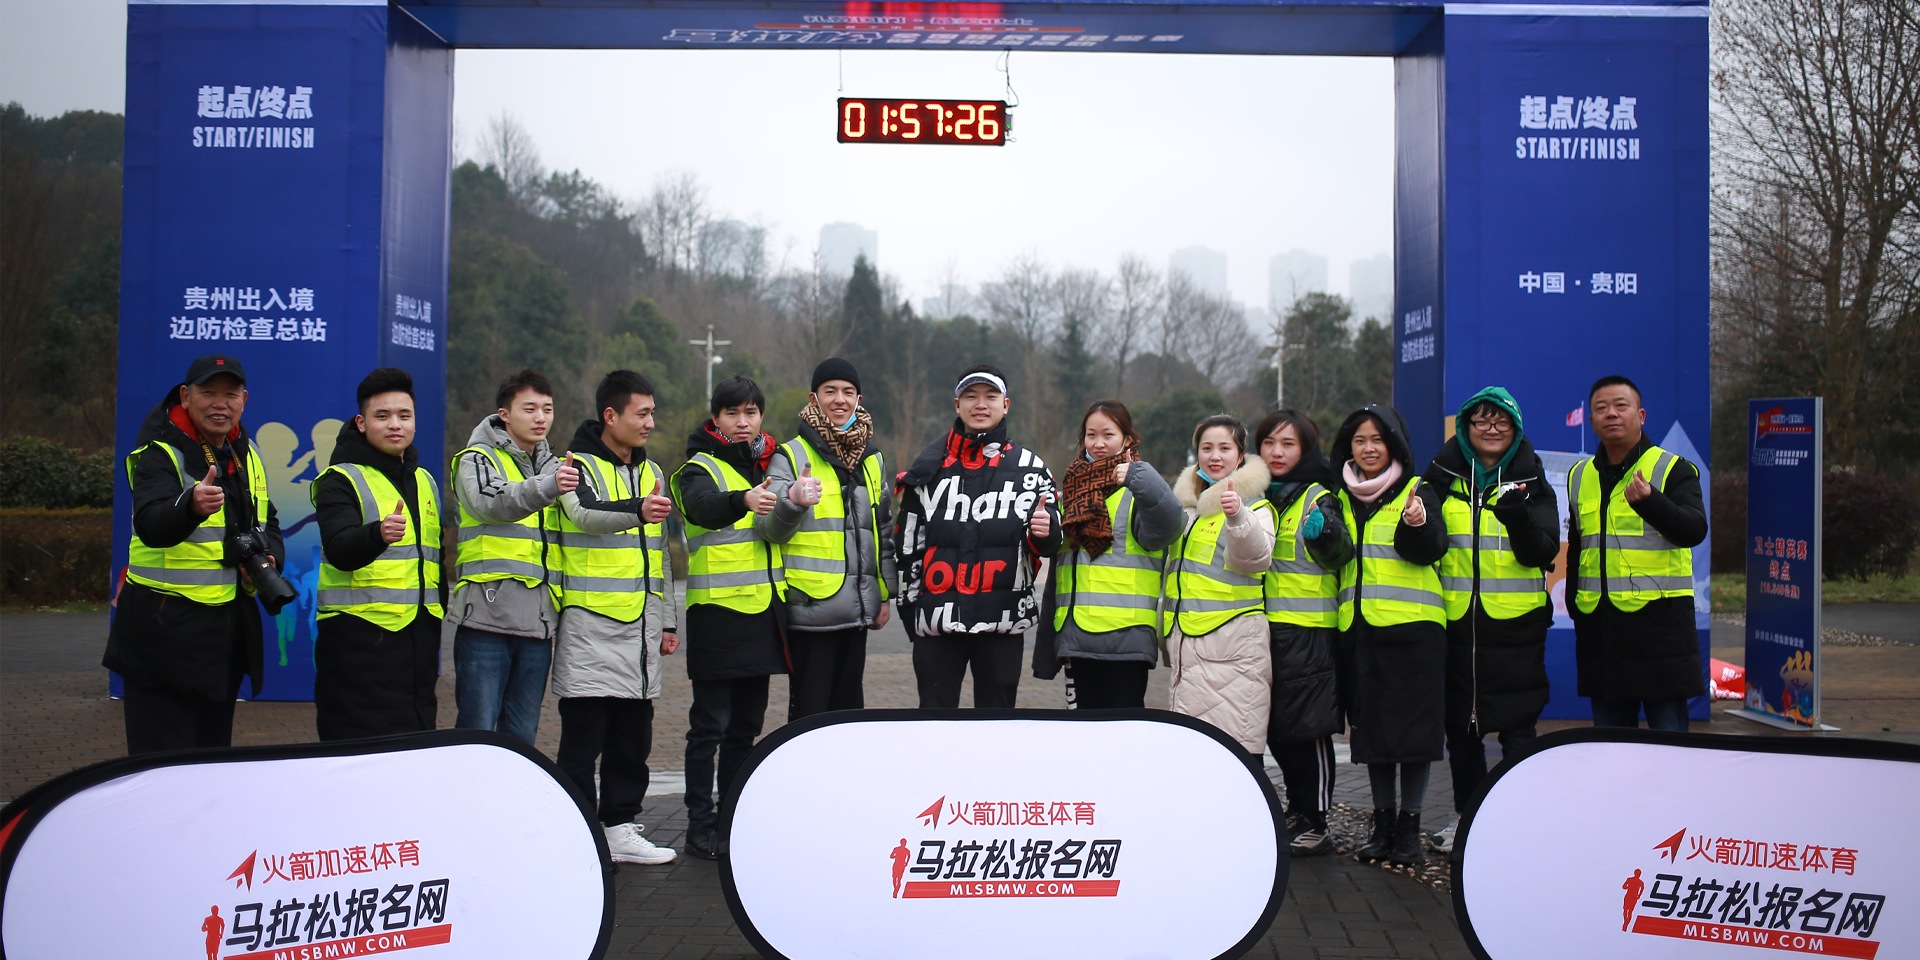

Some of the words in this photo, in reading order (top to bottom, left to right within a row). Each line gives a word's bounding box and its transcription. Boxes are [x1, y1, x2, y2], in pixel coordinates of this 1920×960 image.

[197, 85, 313, 120] 起点/终点
[1519, 94, 1638, 131] 起点/终点
[192, 126, 315, 149] START/FINISH
[1515, 136, 1640, 160] START/FINISH
[184, 287, 314, 312] 贵州出入境
[169, 316, 327, 342] 边防检查总站
[947, 801, 1096, 826] 火箭加速体育
[263, 839, 420, 884] 火箭加速体育
[909, 838, 1122, 880] 马拉松报名网
[1686, 835, 1859, 876] 火箭加速体育
[949, 883, 1076, 896] MLSBMW.COM
[225, 878, 450, 951] 马拉松报名网
[1641, 873, 1886, 938] 马拉松报名网
[1683, 924, 1824, 951] MLSBMW.COM
